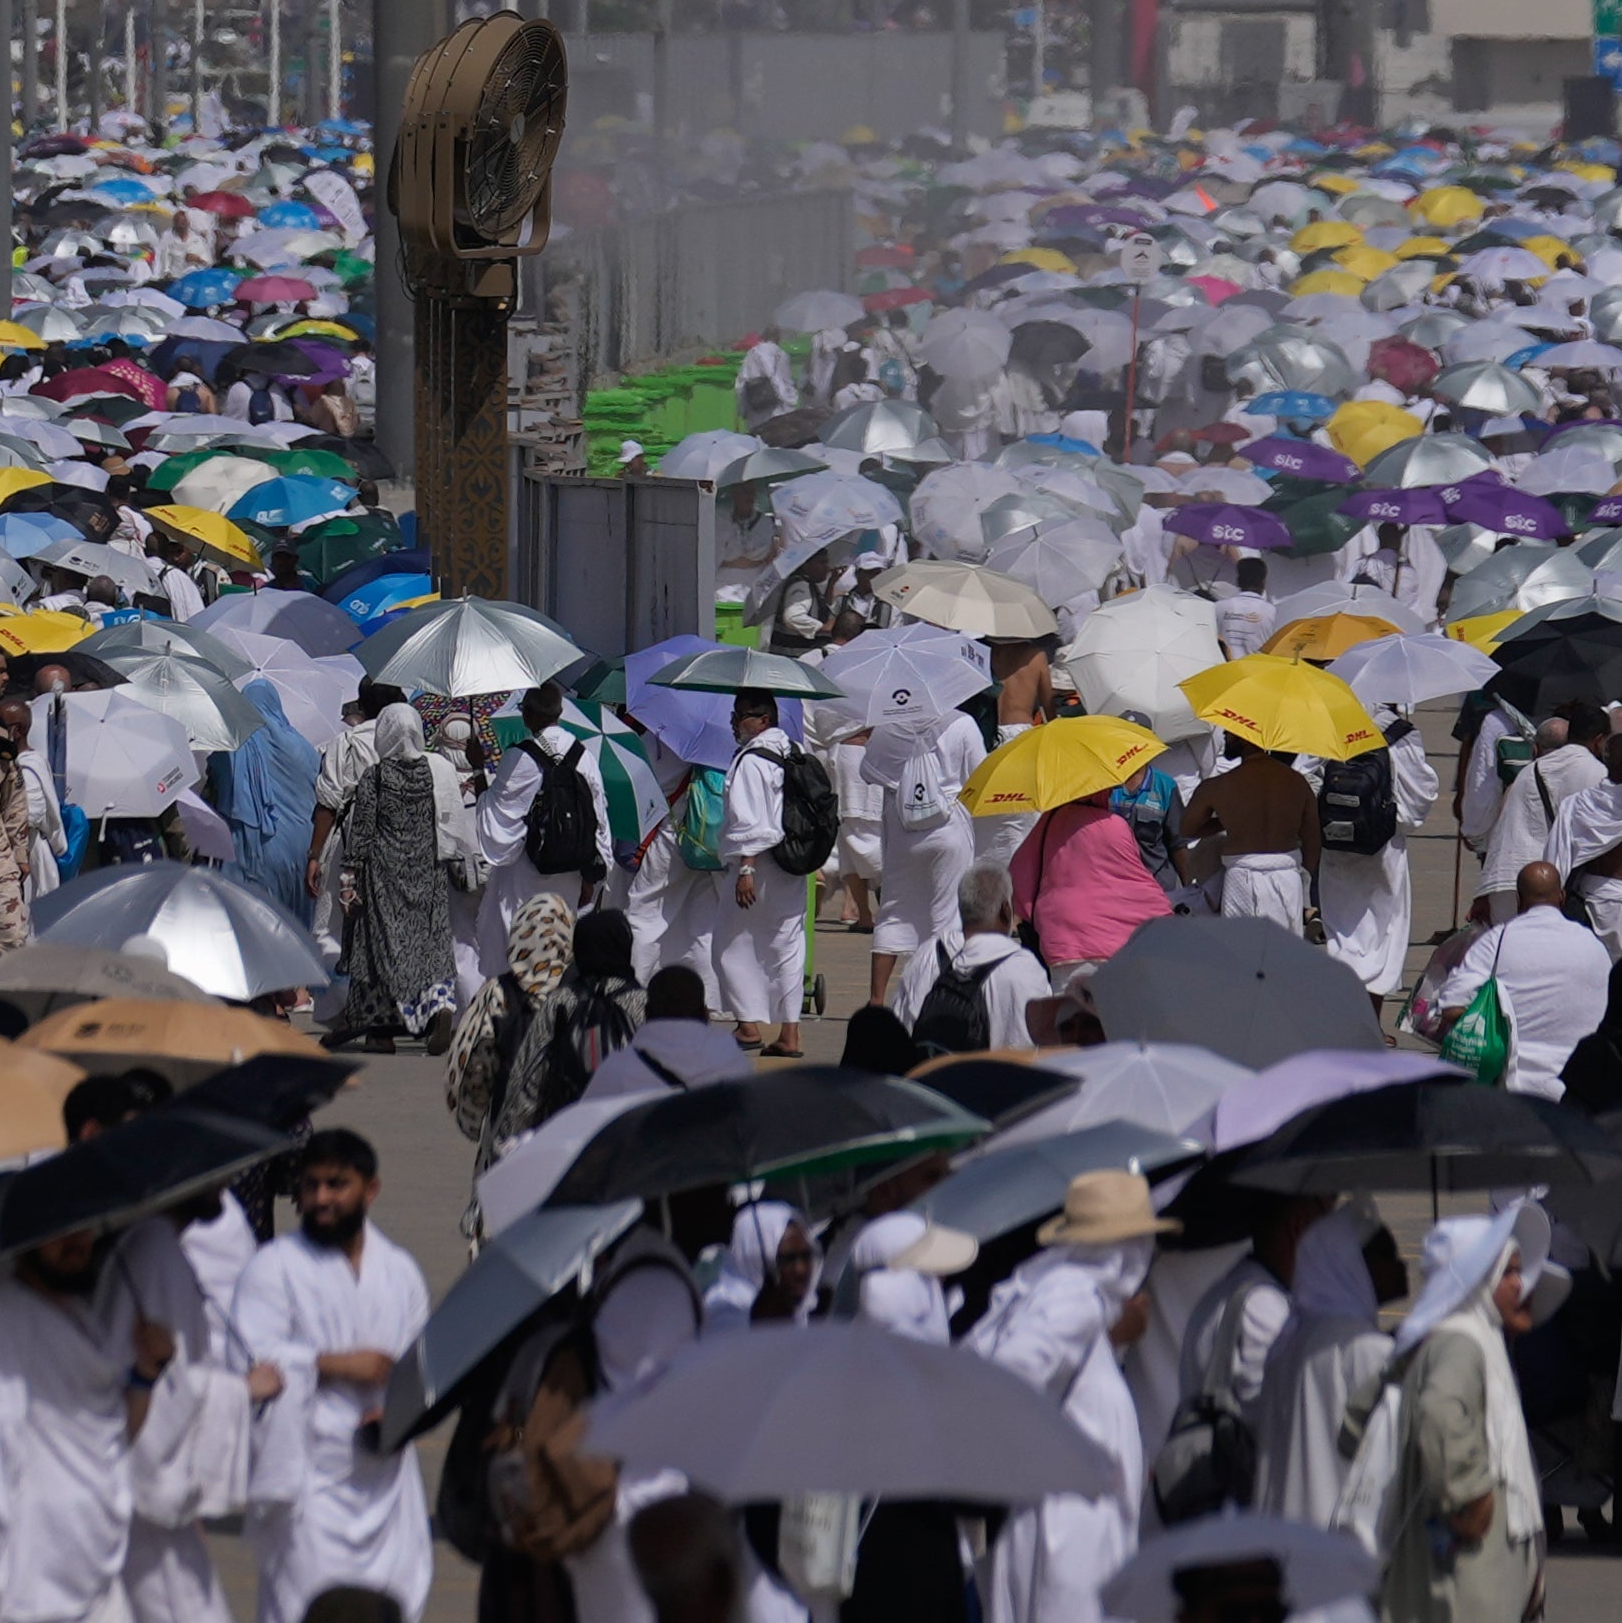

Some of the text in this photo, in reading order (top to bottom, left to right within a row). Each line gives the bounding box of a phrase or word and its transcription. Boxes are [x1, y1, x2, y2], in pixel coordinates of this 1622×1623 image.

[1272, 454, 1303, 470] stc
[1370, 502, 1401, 517] stc
[1504, 514, 1537, 532] stc
[1212, 525, 1245, 540] stc
[1215, 708, 1261, 733] DHL
[1344, 730, 1374, 744] DHL
[1115, 742, 1148, 769] DHL
[986, 793, 1031, 803] DHL
